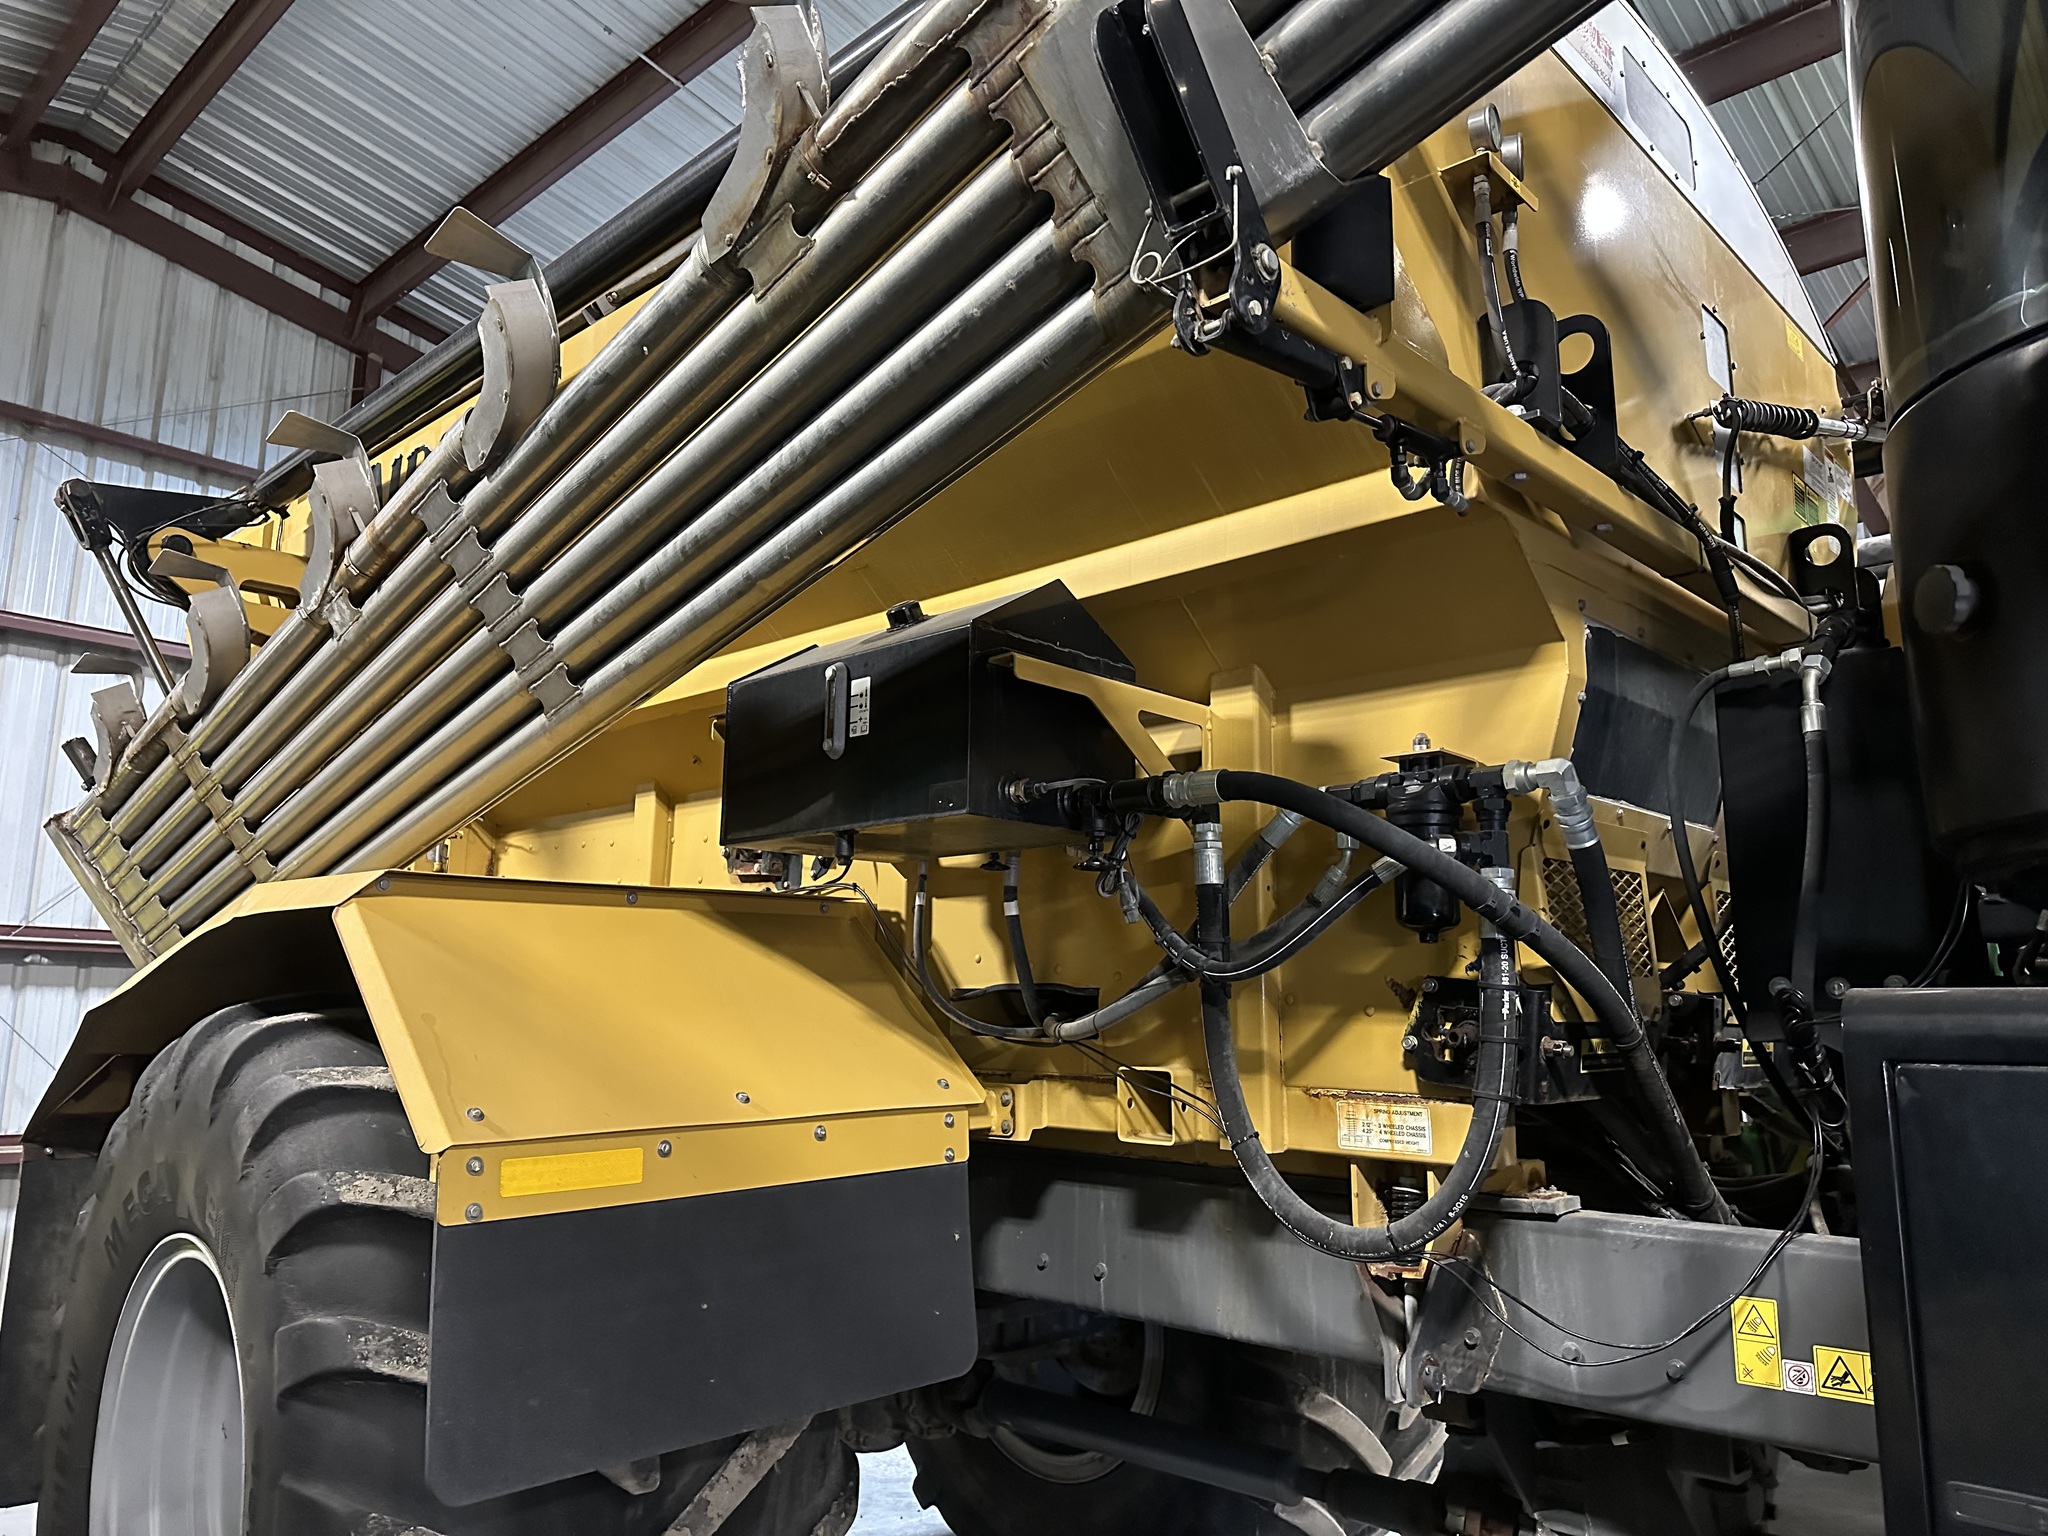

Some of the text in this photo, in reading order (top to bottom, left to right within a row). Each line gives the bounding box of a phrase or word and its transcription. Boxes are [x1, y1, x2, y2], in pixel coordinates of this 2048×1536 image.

[1510, 254, 1520, 286] Worldwide
[1508, 352, 1518, 370] MADE
[1501, 990, 1510, 1014] Parker
[1410, 1238, 1424, 1249] mm
